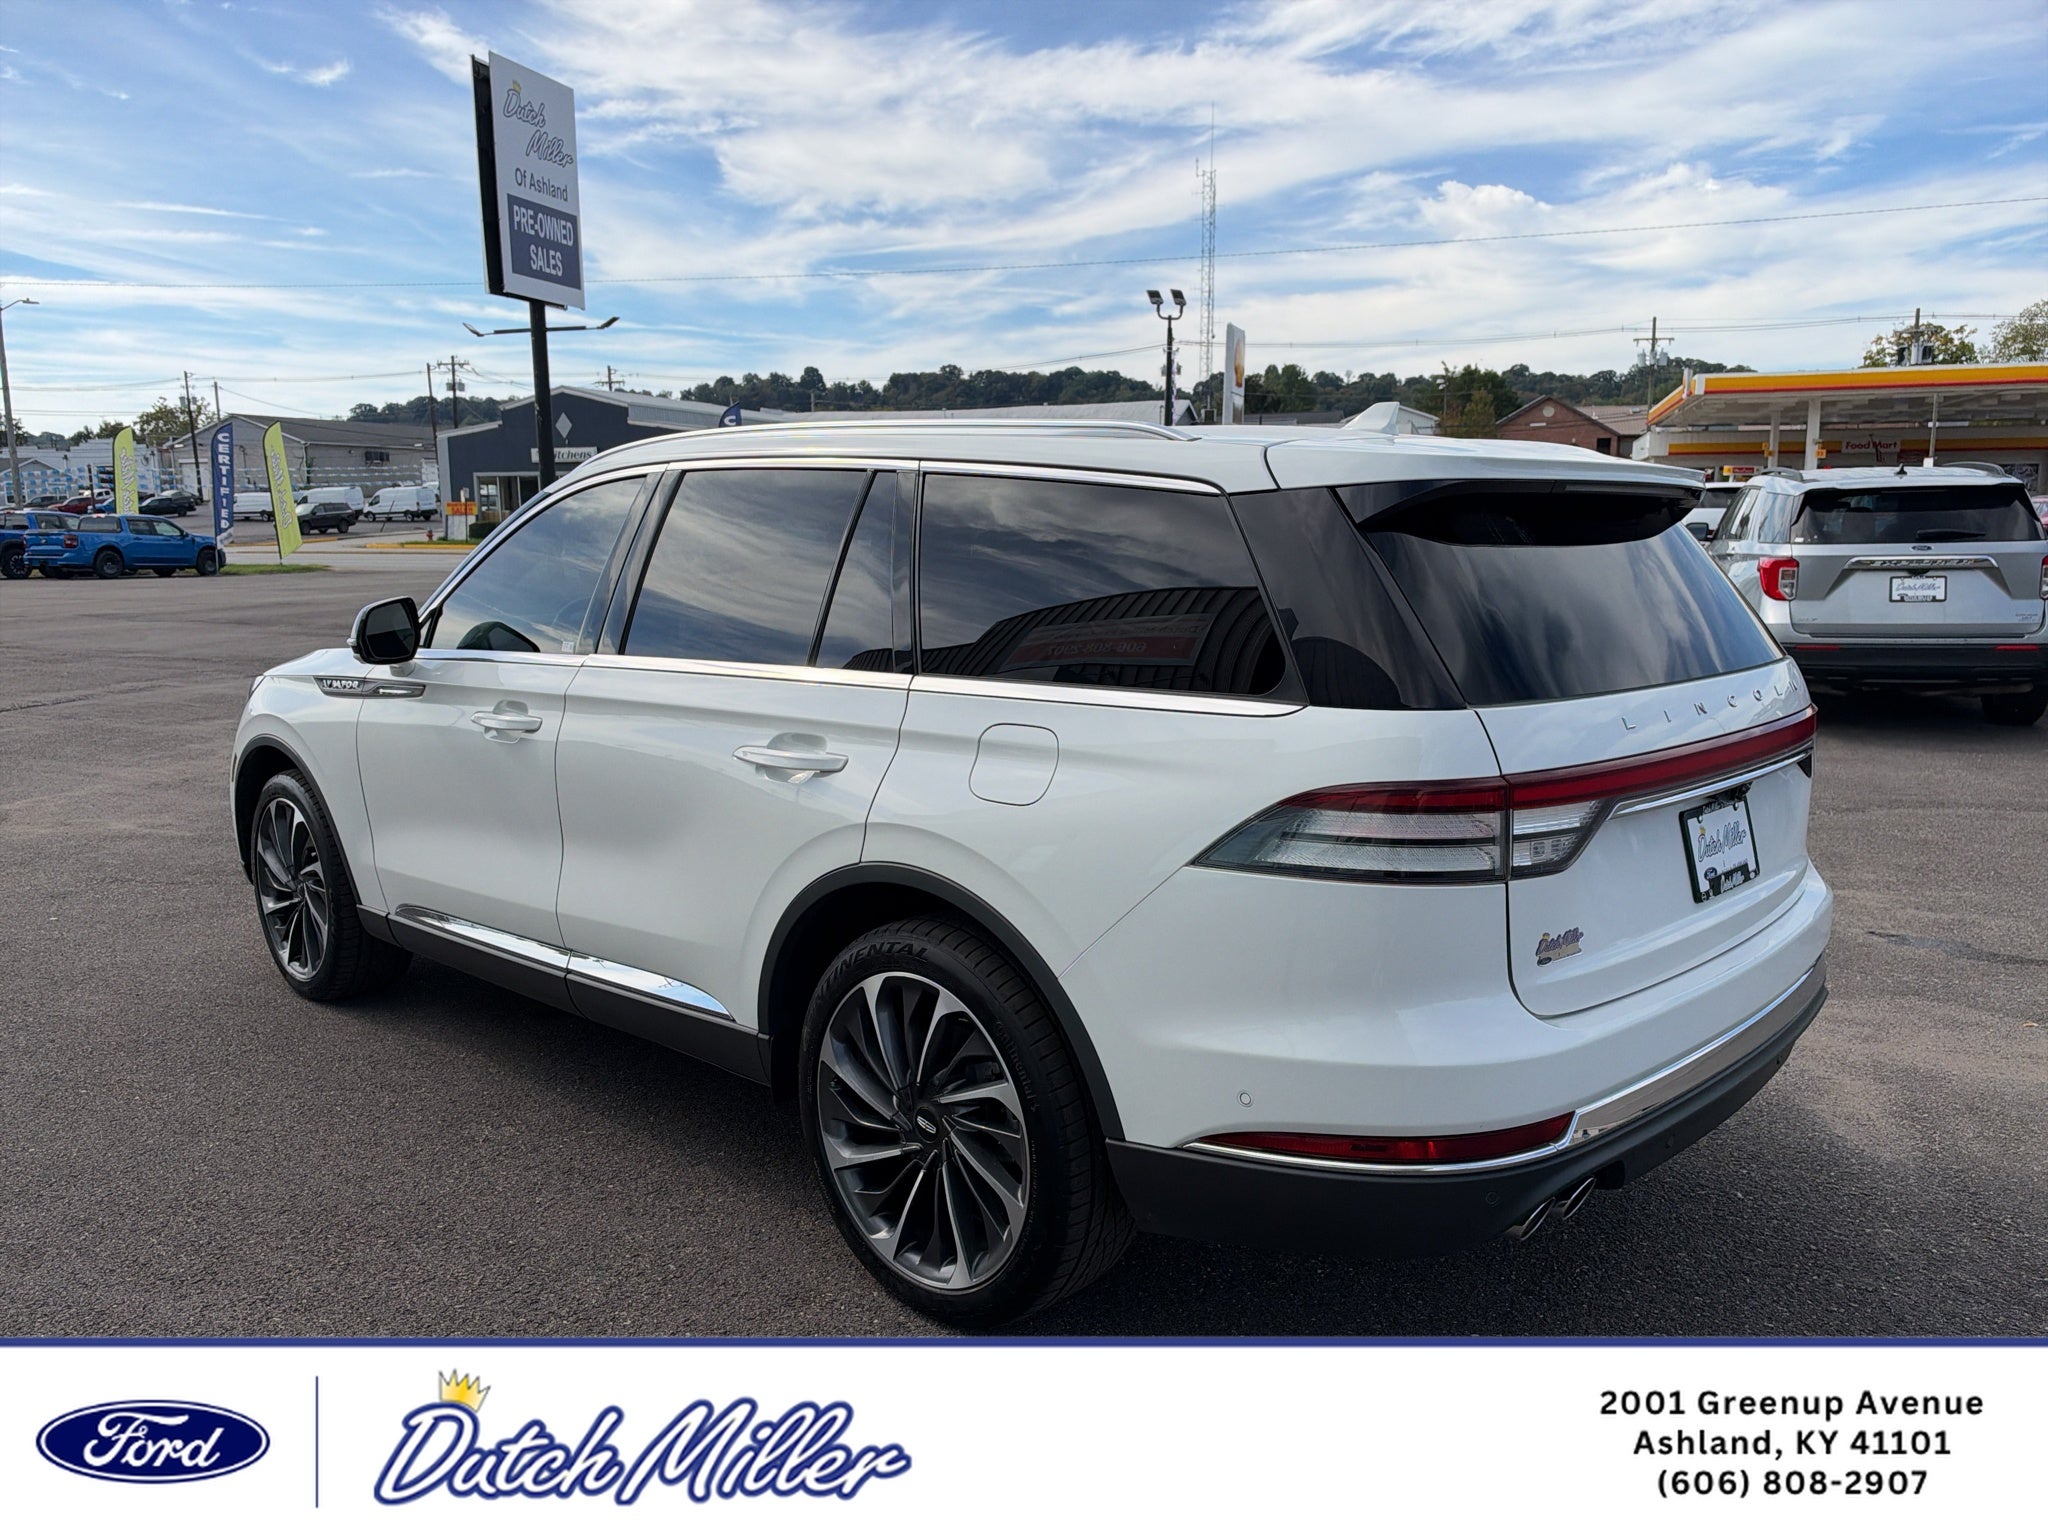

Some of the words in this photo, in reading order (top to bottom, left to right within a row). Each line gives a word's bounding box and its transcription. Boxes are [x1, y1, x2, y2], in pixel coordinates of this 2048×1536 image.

[503, 88, 546, 128] Dutch
[525, 130, 574, 168] Miller
[515, 167, 527, 188] Of
[529, 173, 568, 202] Ashland
[513, 204, 574, 247] PRE-OWNED
[530, 244, 563, 277] SALES
[554, 449, 592, 460] itchens
[1845, 441, 1870, 450] Food
[1872, 440, 1898, 449] Mart
[217, 432, 231, 529] CERTIFIED
[1621, 680, 1799, 731] LINCOLN
[1698, 828, 1722, 863] Dutch
[1720, 820, 1747, 855] Miller
